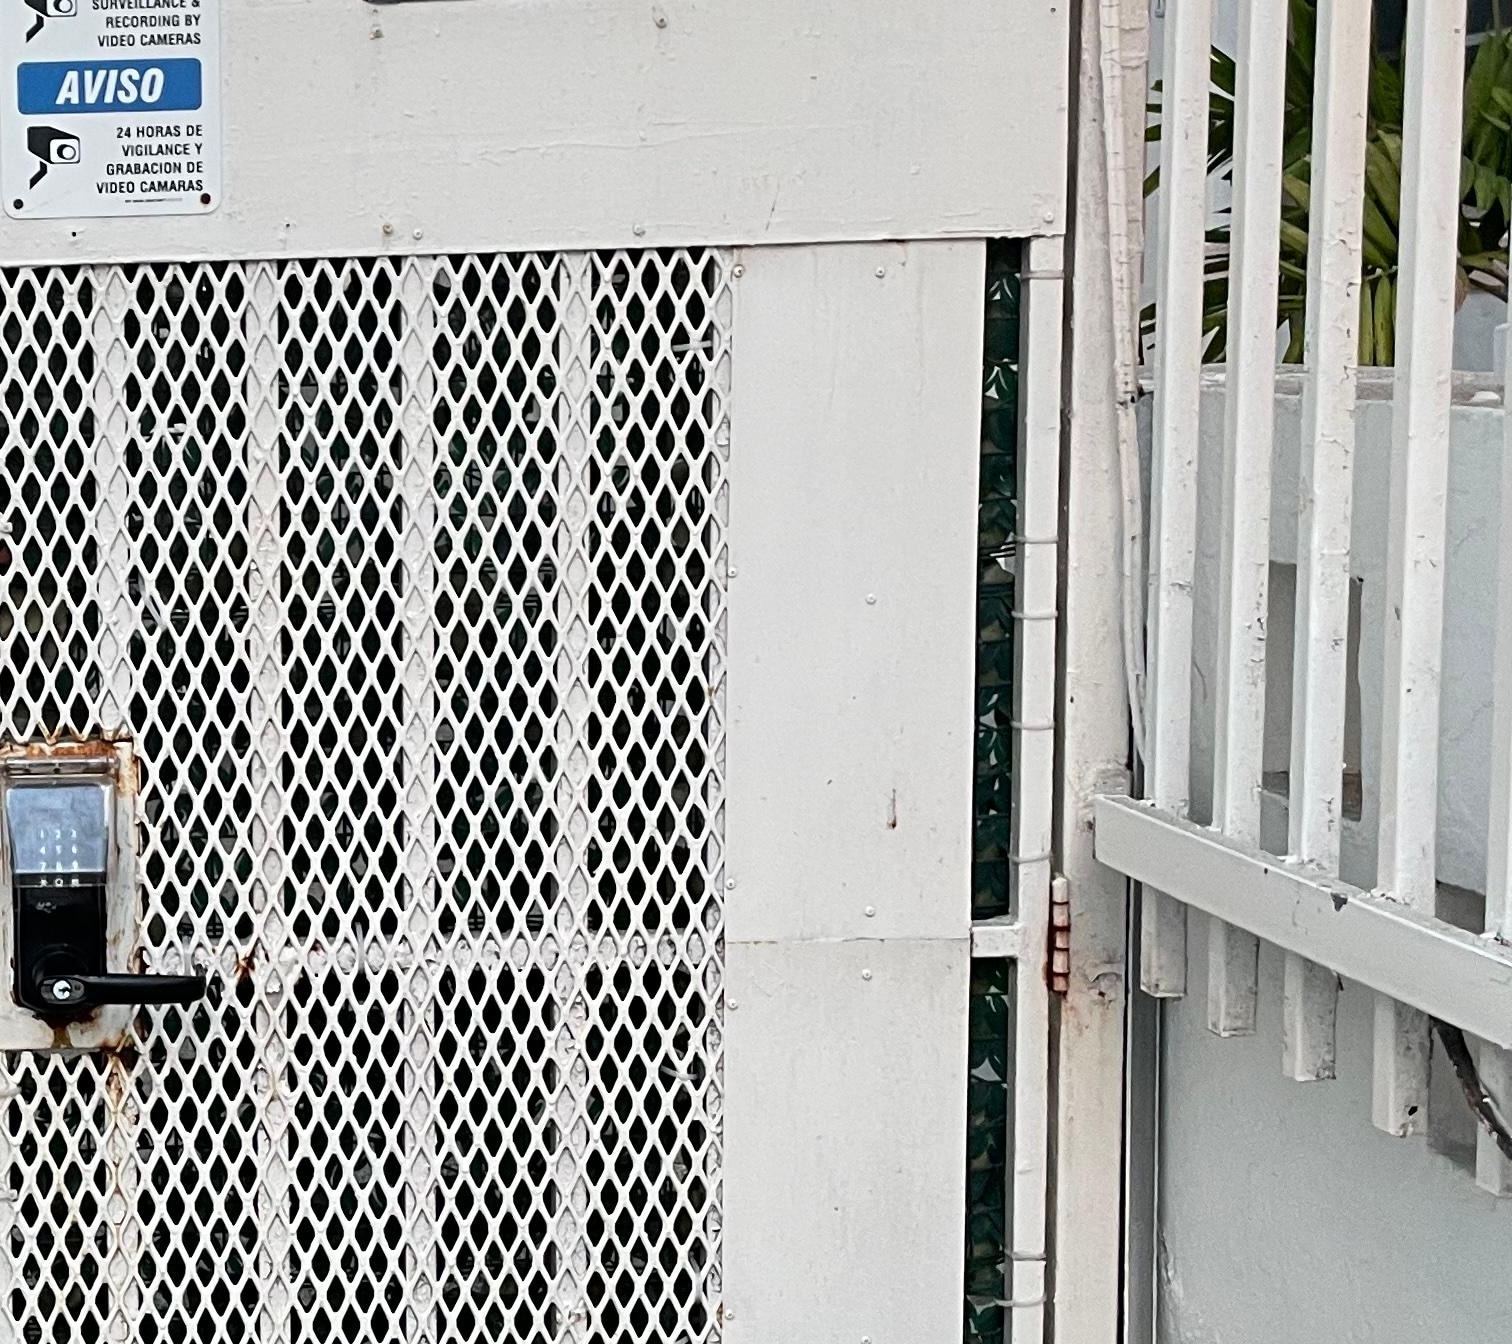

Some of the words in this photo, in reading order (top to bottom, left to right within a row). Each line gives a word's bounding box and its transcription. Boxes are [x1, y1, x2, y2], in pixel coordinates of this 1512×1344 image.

[106, 15, 180, 28] RECORDING
[184, 14, 201, 26] BY
[97, 34, 136, 47] VIDEO
[140, 32, 202, 46] CAMERAS
[55, 67, 165, 105] AVISO
[116, 126, 131, 138] 24
[136, 125, 181, 138] HORAS
[186, 124, 203, 137] DE
[121, 143, 190, 157] VIGILANCE
[194, 142, 203, 155] Y
[106, 161, 181, 175] GRABACION
[186, 160, 203, 173] DE
[96, 181, 135, 194] VIDEO
[140, 179, 203, 193] CAMARAS
